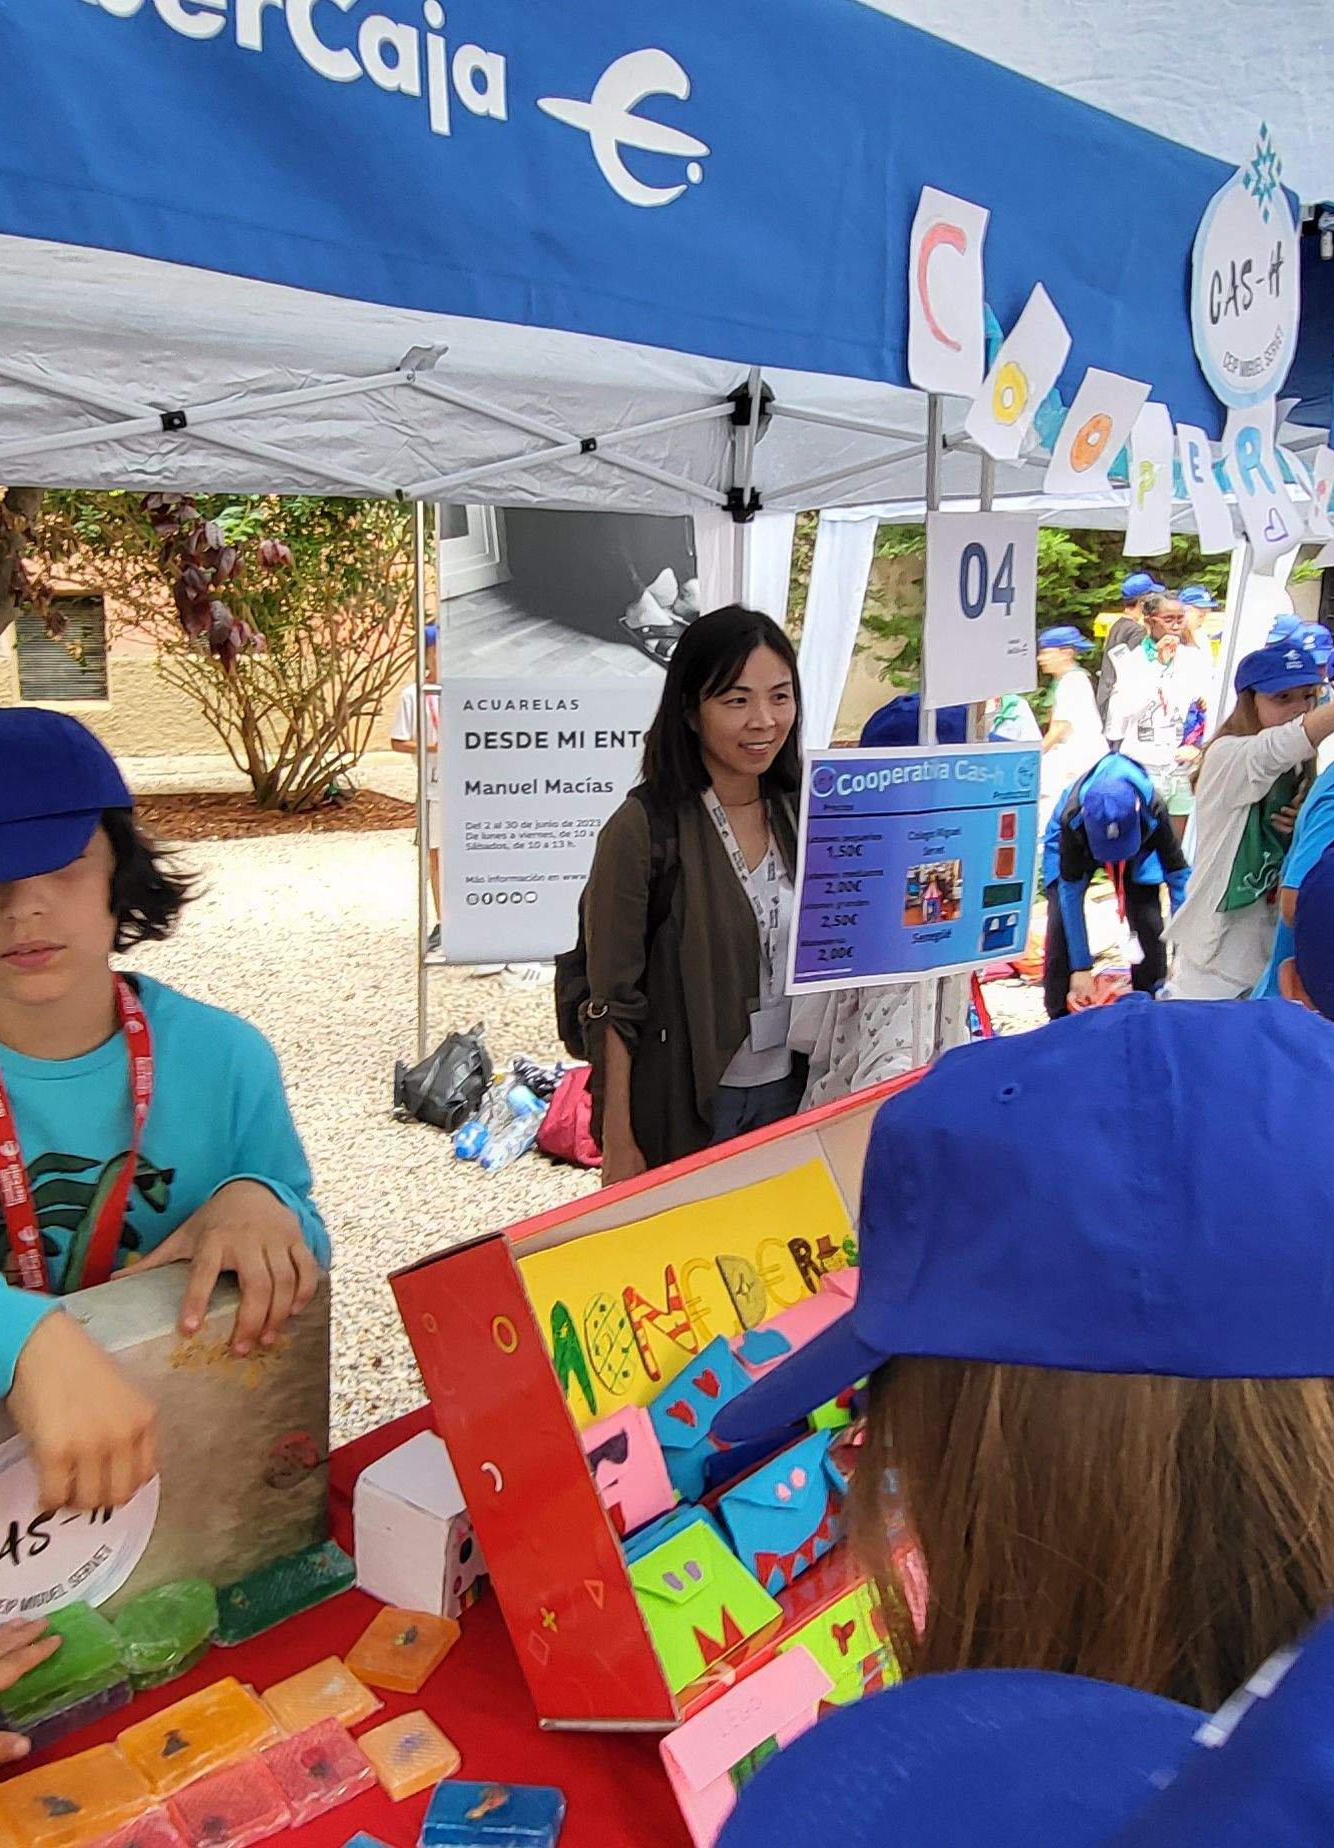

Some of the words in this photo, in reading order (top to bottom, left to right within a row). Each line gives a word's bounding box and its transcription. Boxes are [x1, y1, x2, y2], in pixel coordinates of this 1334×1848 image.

[1209, 240, 1284, 326] CAS-H
[959, 541, 1016, 620] 04
[463, 699, 581, 711] ACUARELAS
[464, 731, 550, 750] DESDE
[557, 730, 585, 749] MI
[464, 779, 538, 796] Manuel
[545, 776, 614, 794] Macías
